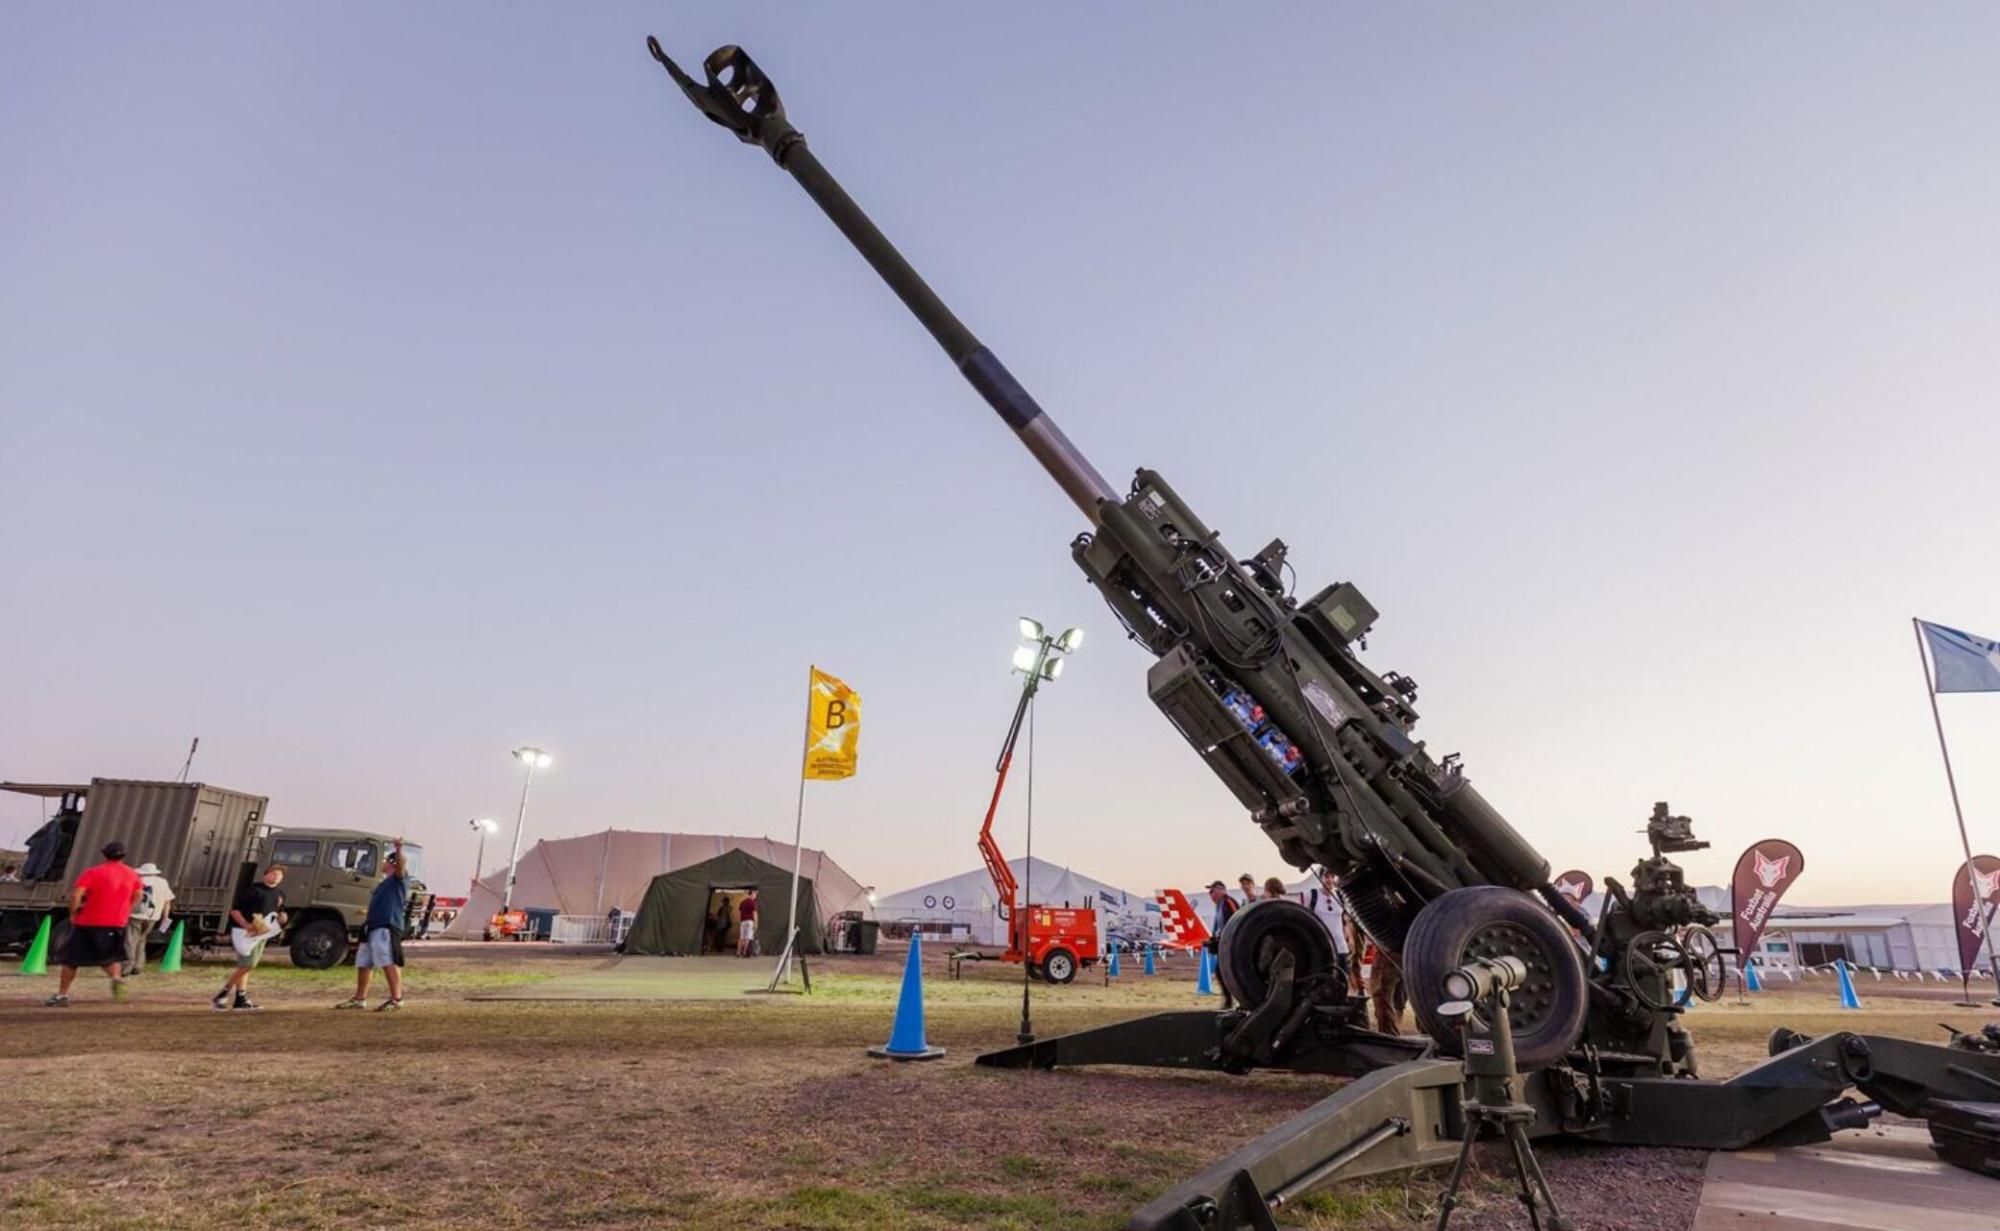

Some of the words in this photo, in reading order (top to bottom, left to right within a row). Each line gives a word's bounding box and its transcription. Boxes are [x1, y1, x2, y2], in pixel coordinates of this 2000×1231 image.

[826, 700, 846, 729] B
[1740, 888, 1765, 921] Foxbat
[1749, 891, 1777, 932] Australia
